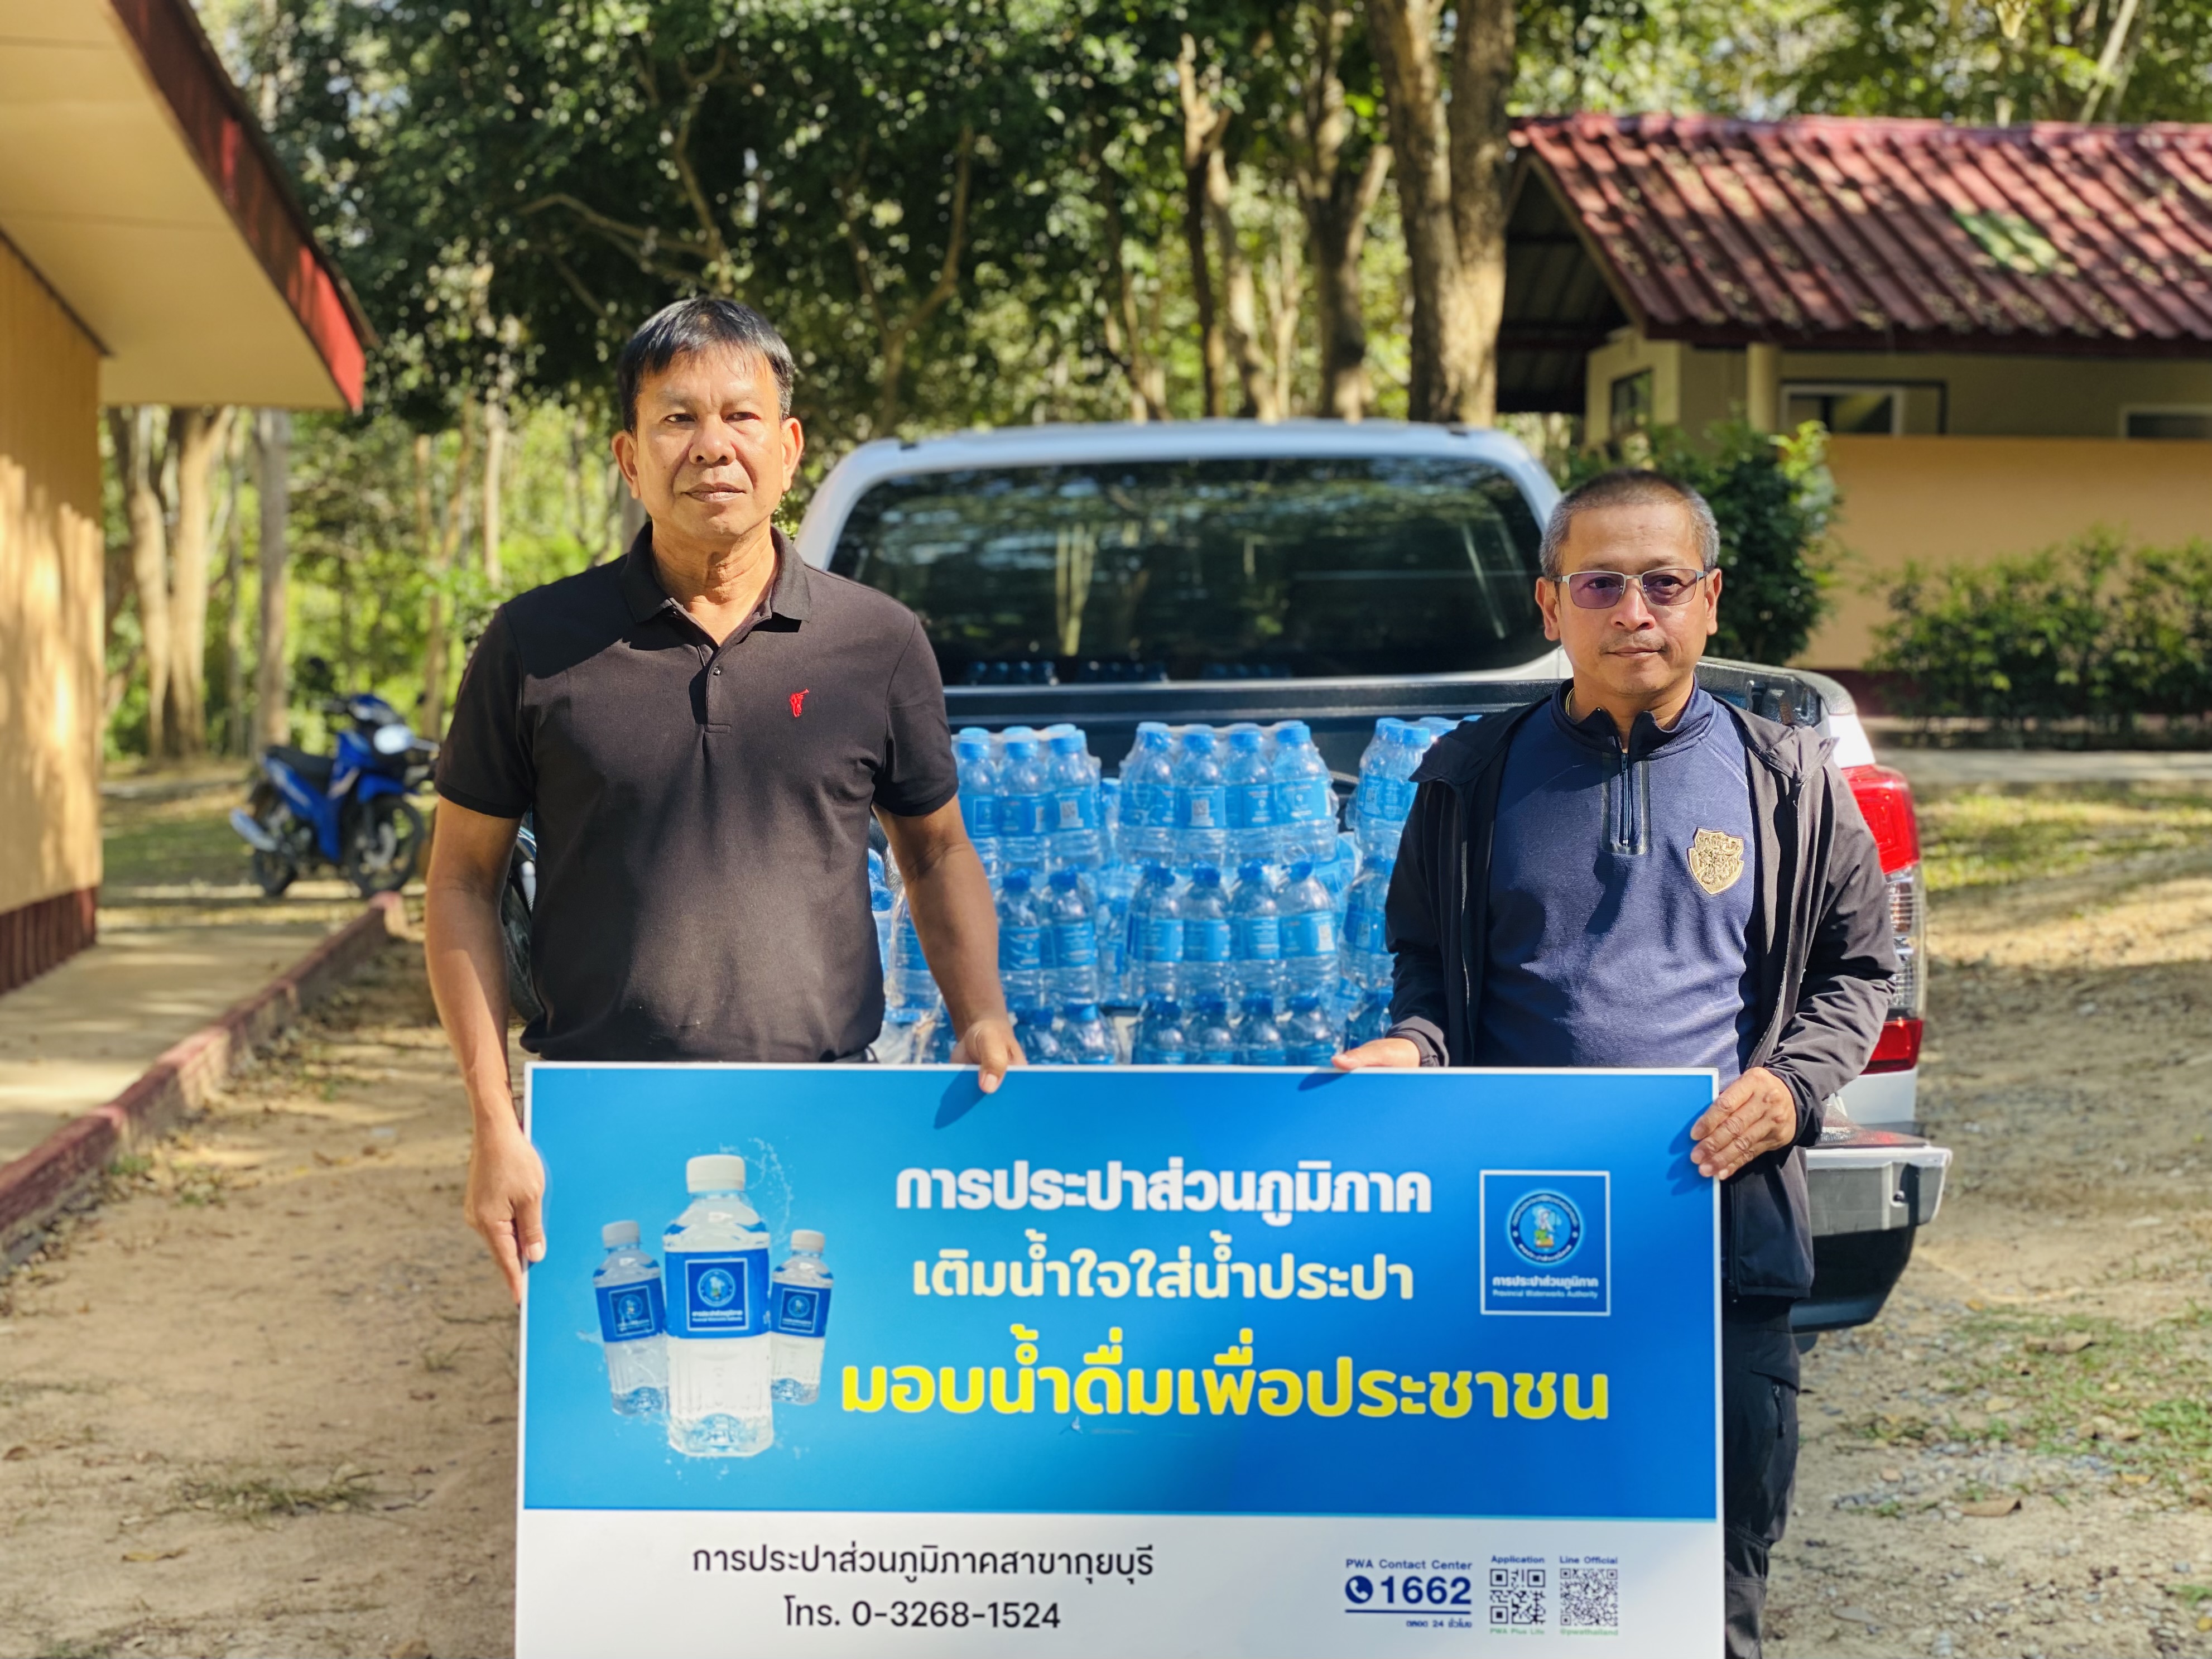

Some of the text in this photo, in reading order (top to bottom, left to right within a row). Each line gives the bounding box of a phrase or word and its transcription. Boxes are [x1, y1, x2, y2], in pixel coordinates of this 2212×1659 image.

[896, 1156, 1432, 1227] การประปาส่วนภูมิภาค
[913, 1228, 1413, 1300] เติมน้ำใจใส่น้ำประปา
[841, 1324, 1608, 1420] มอบน้ำดื่มเพื่อประชาชน
[692, 1541, 1153, 1584] การประปาส่วนภูมิภาคสาขากุยบุรี
[1346, 1559, 1472, 1570] PWA Contact Center
[1491, 1555, 1545, 1564] Application
[1381, 1575, 1472, 1604] 1662
[783, 1595, 1061, 1628] โทร. 0-3268-1524
